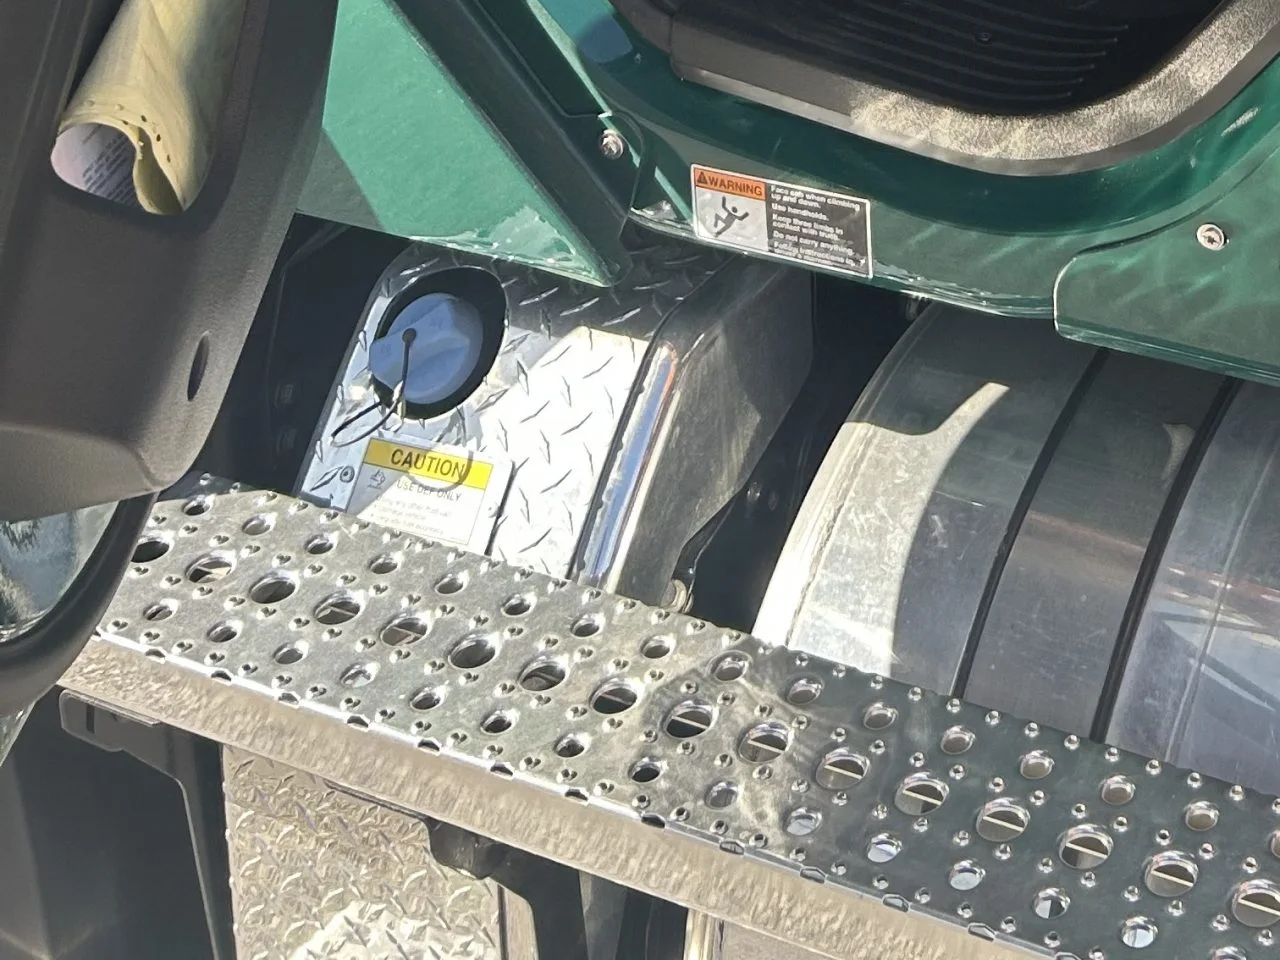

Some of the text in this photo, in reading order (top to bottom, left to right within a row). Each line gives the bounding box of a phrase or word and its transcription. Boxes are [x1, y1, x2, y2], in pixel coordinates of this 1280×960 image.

[708, 176, 763, 197] WARNING
[771, 185, 789, 195] Face
[805, 193, 826, 203] when
[827, 198, 860, 212] climbing
[771, 193, 821, 209] up and down.
[772, 203, 787, 212] Use
[773, 213, 792, 224] Keep
[793, 218, 813, 228] three
[835, 227, 844, 235] in
[773, 221, 801, 232] contact
[801, 226, 818, 236] with
[773, 230, 784, 239] Do
[785, 234, 798, 242] not
[799, 237, 819, 248] carry
[391, 448, 467, 478] CAUTION
[397, 479, 414, 492] USE
[437, 489, 462, 501] ONLY
